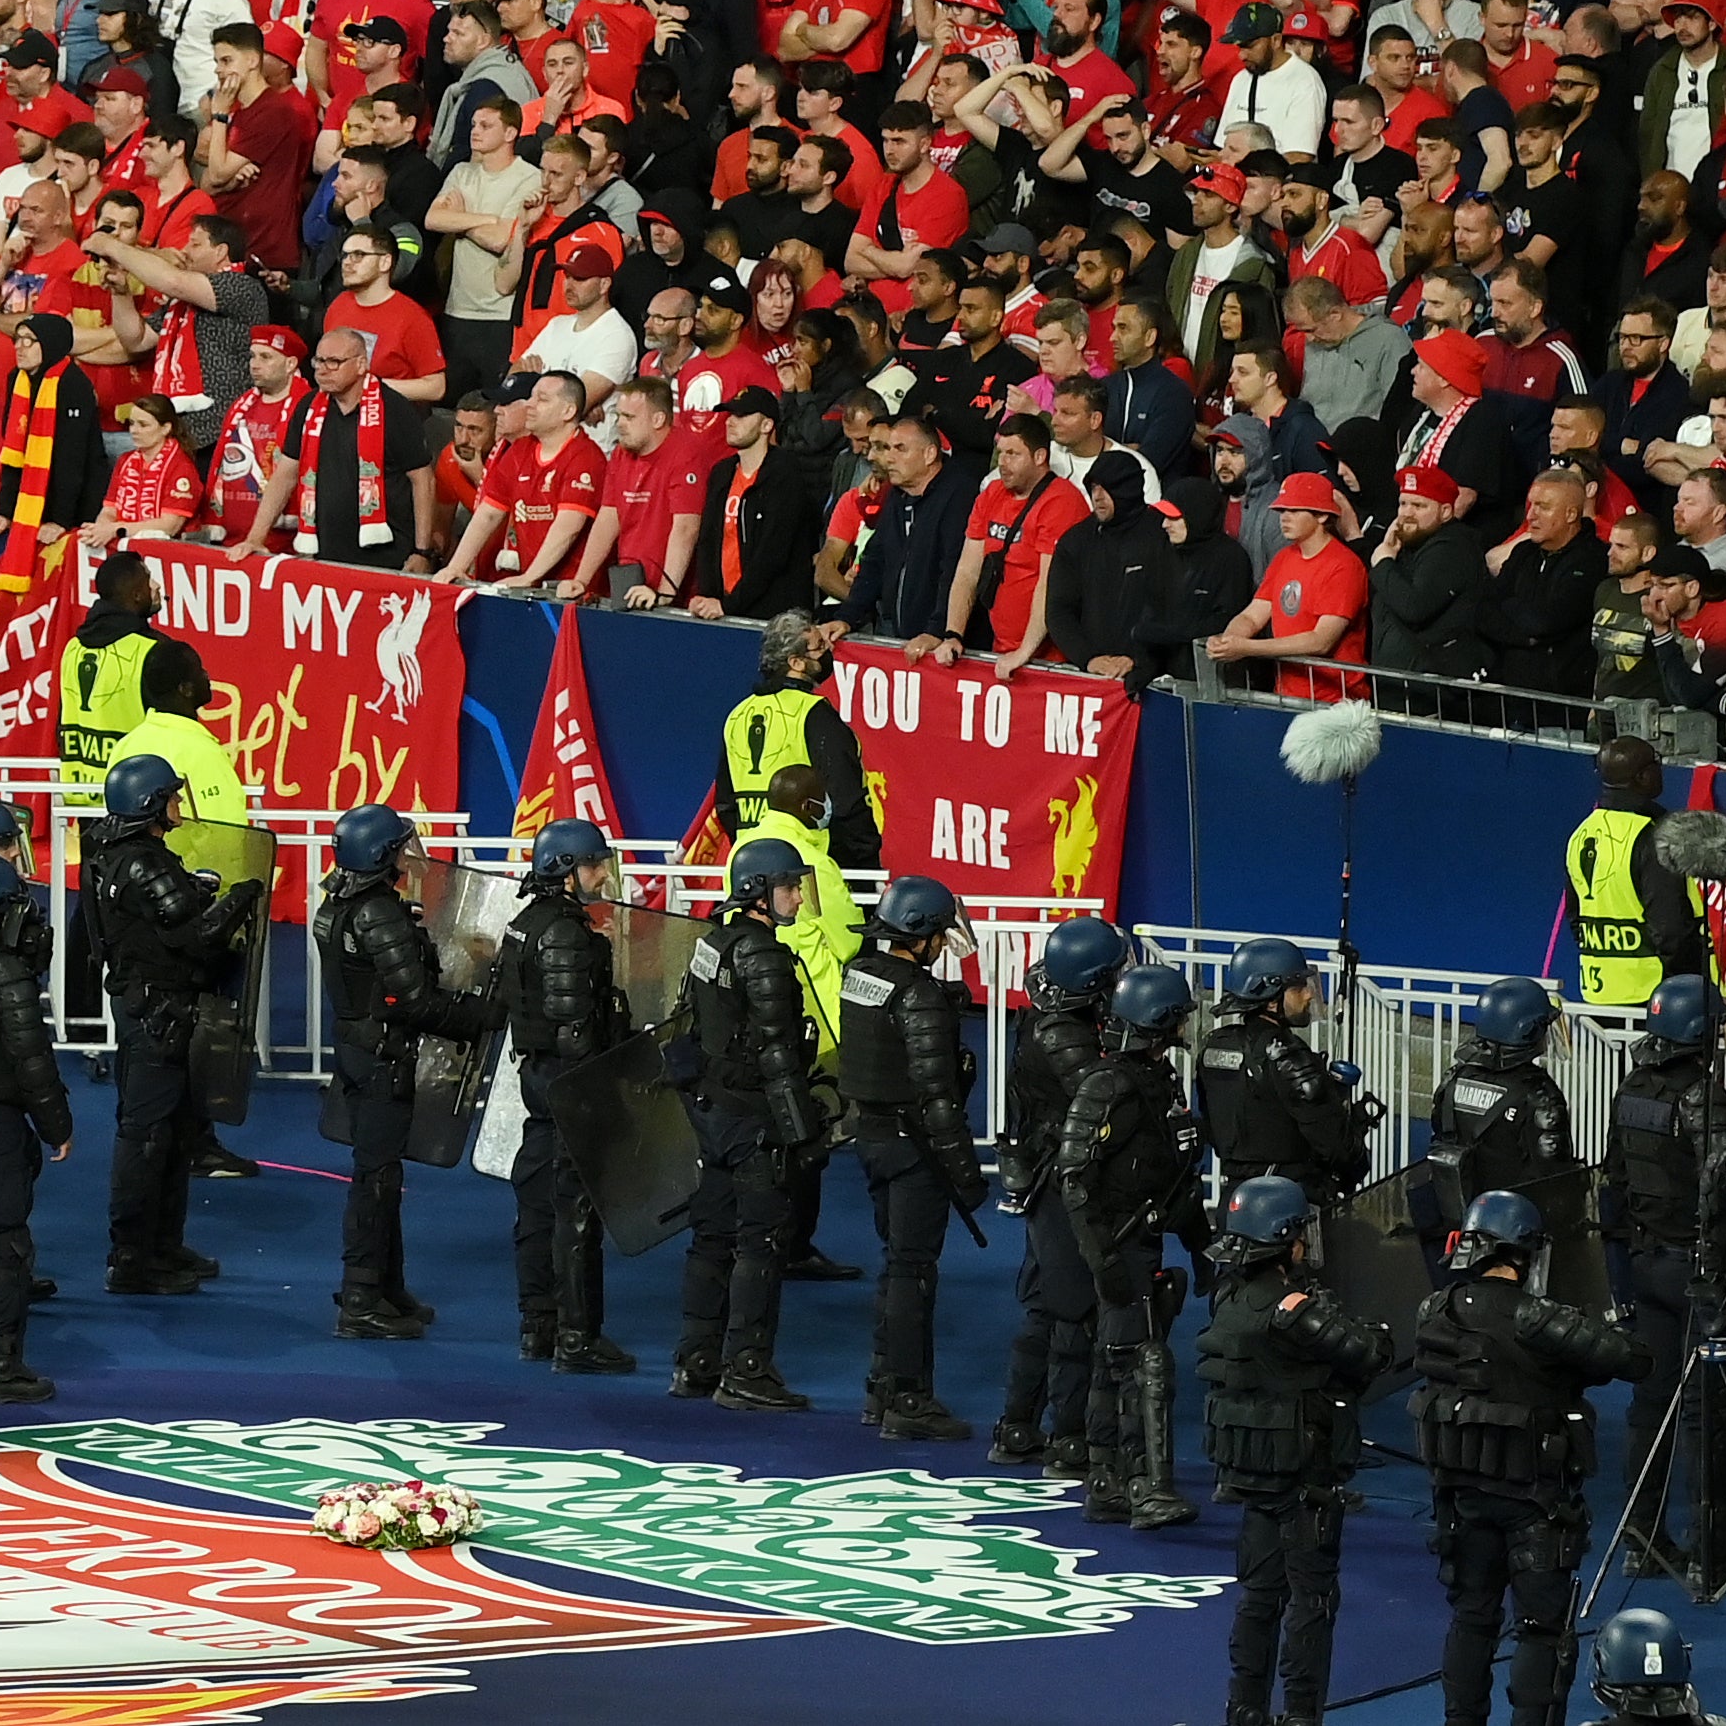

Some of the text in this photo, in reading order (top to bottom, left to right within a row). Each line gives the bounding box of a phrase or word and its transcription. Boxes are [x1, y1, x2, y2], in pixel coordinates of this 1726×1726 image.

[282, 582, 363, 658] MY
[833, 661, 1103, 758] YOU TO ME
[930, 797, 1011, 871] ARE
[524, 1525, 1023, 1638] WALK ALONE
[51, 1598, 311, 1652] CLUB
